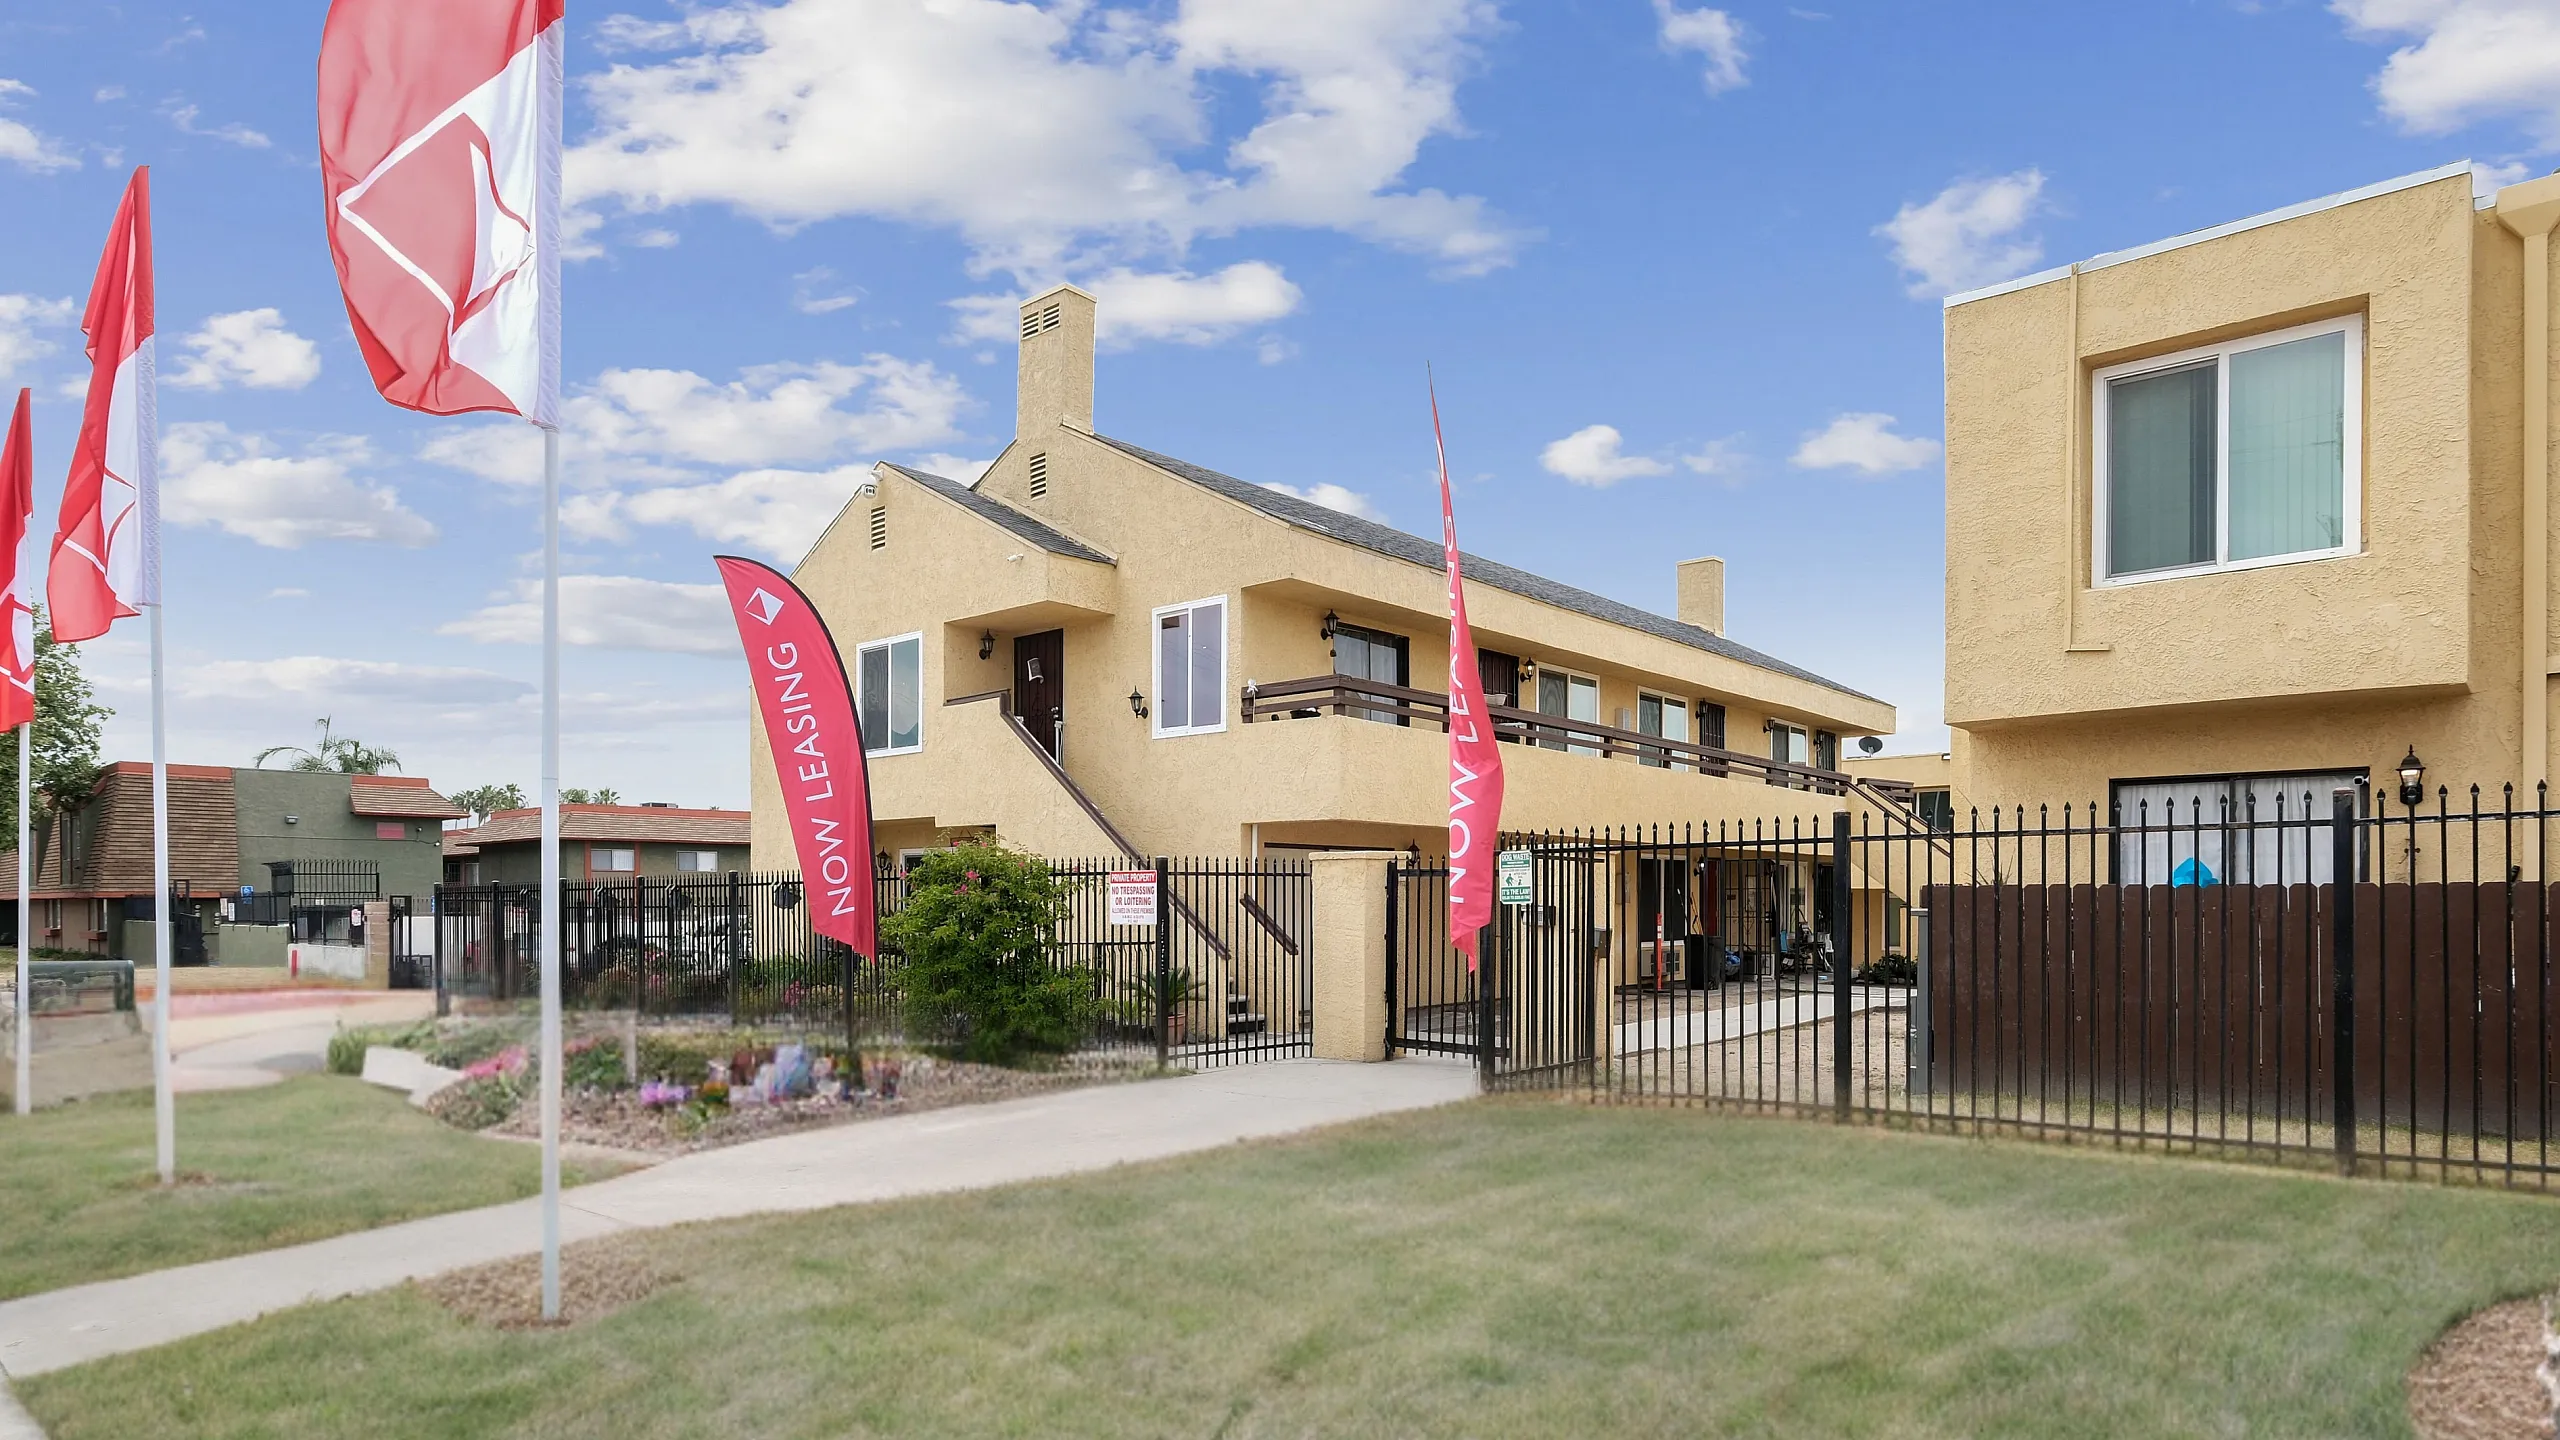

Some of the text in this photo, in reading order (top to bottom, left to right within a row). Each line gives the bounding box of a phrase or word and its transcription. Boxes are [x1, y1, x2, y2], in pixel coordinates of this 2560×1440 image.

[767, 641, 855, 917] NOW LEASING
[1449, 759, 1479, 904] NOW
[1111, 873, 1156, 882] PRIVATE PROPERTY
[1112, 886, 1155, 895] NO TRESPASSING
[1115, 897, 1152, 906] OR LOITERING
